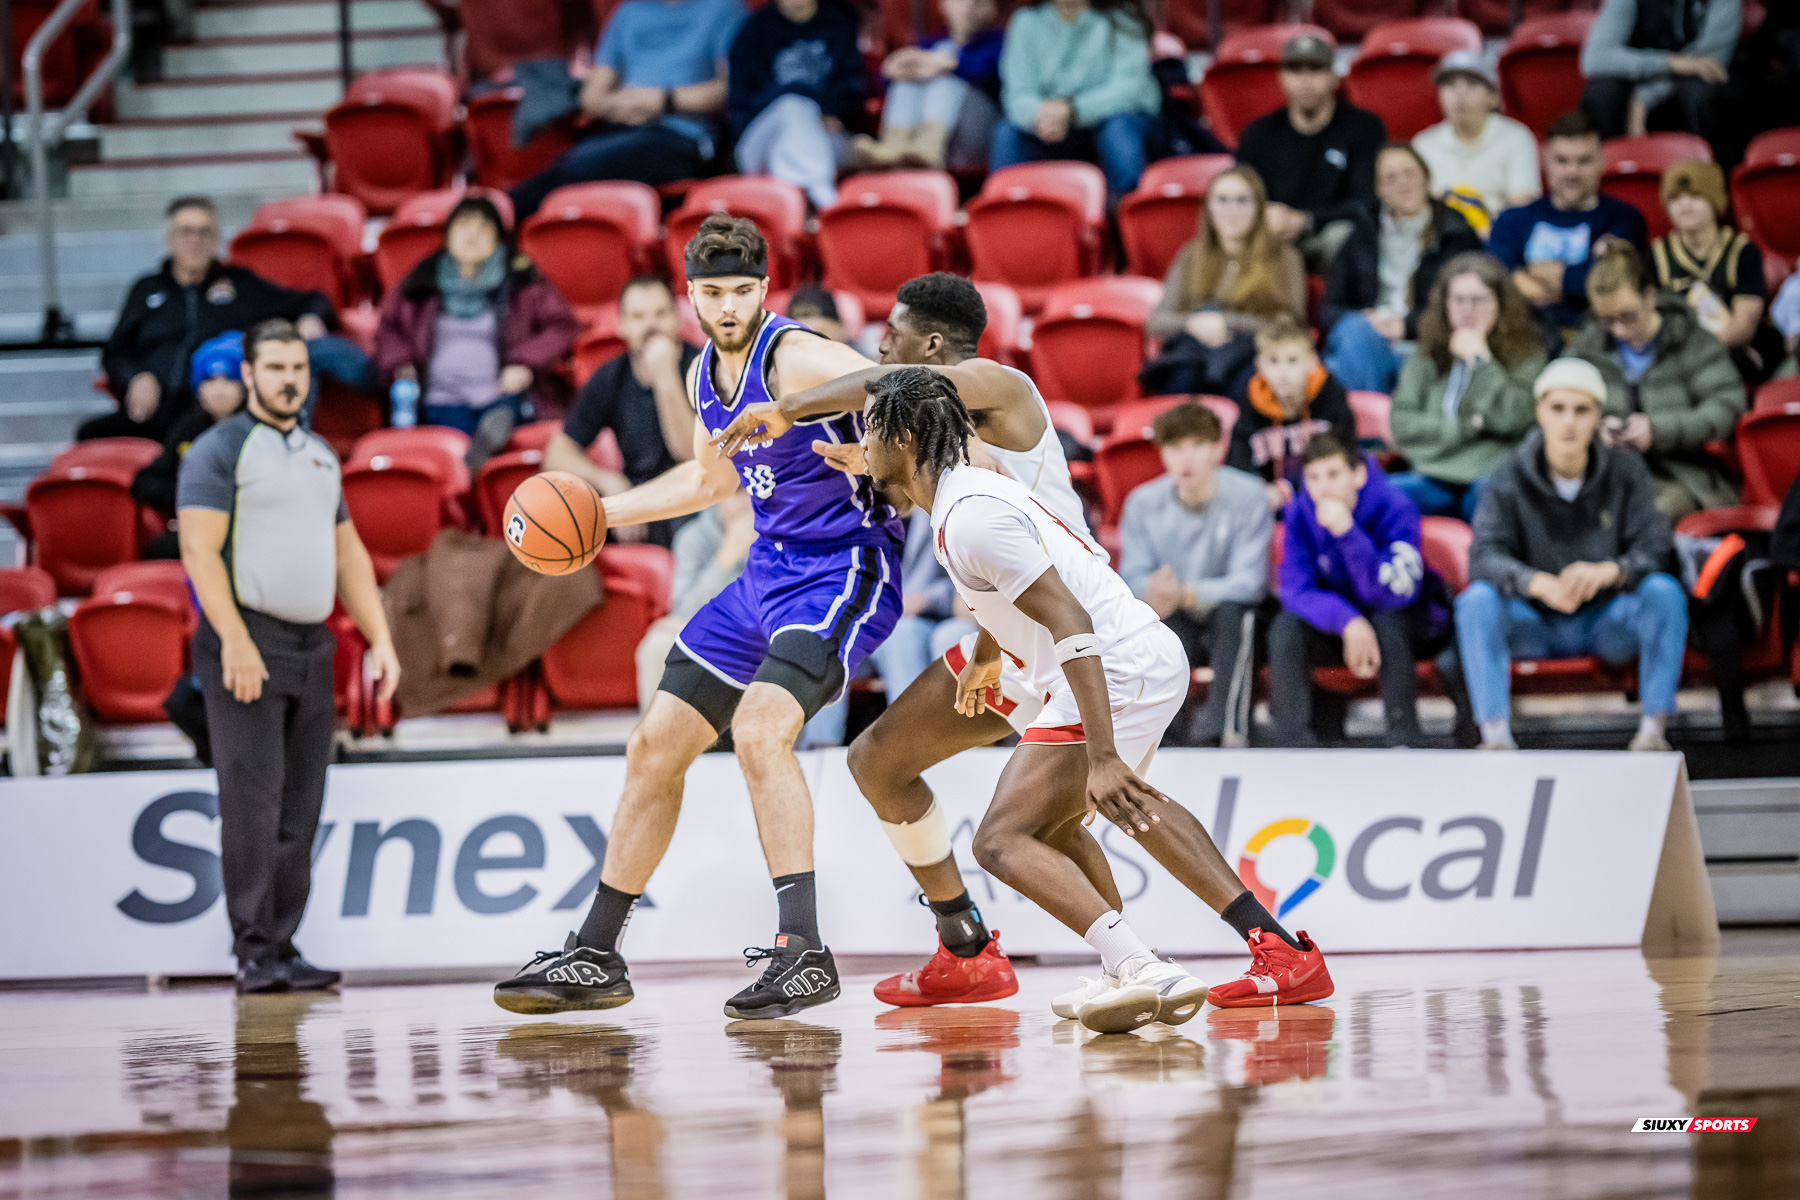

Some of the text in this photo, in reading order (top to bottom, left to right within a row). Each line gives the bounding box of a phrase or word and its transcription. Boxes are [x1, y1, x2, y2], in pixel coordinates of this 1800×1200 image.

[115, 790, 657, 924] Snex
[546, 961, 609, 985] AIR
[782, 967, 831, 997] AIR
